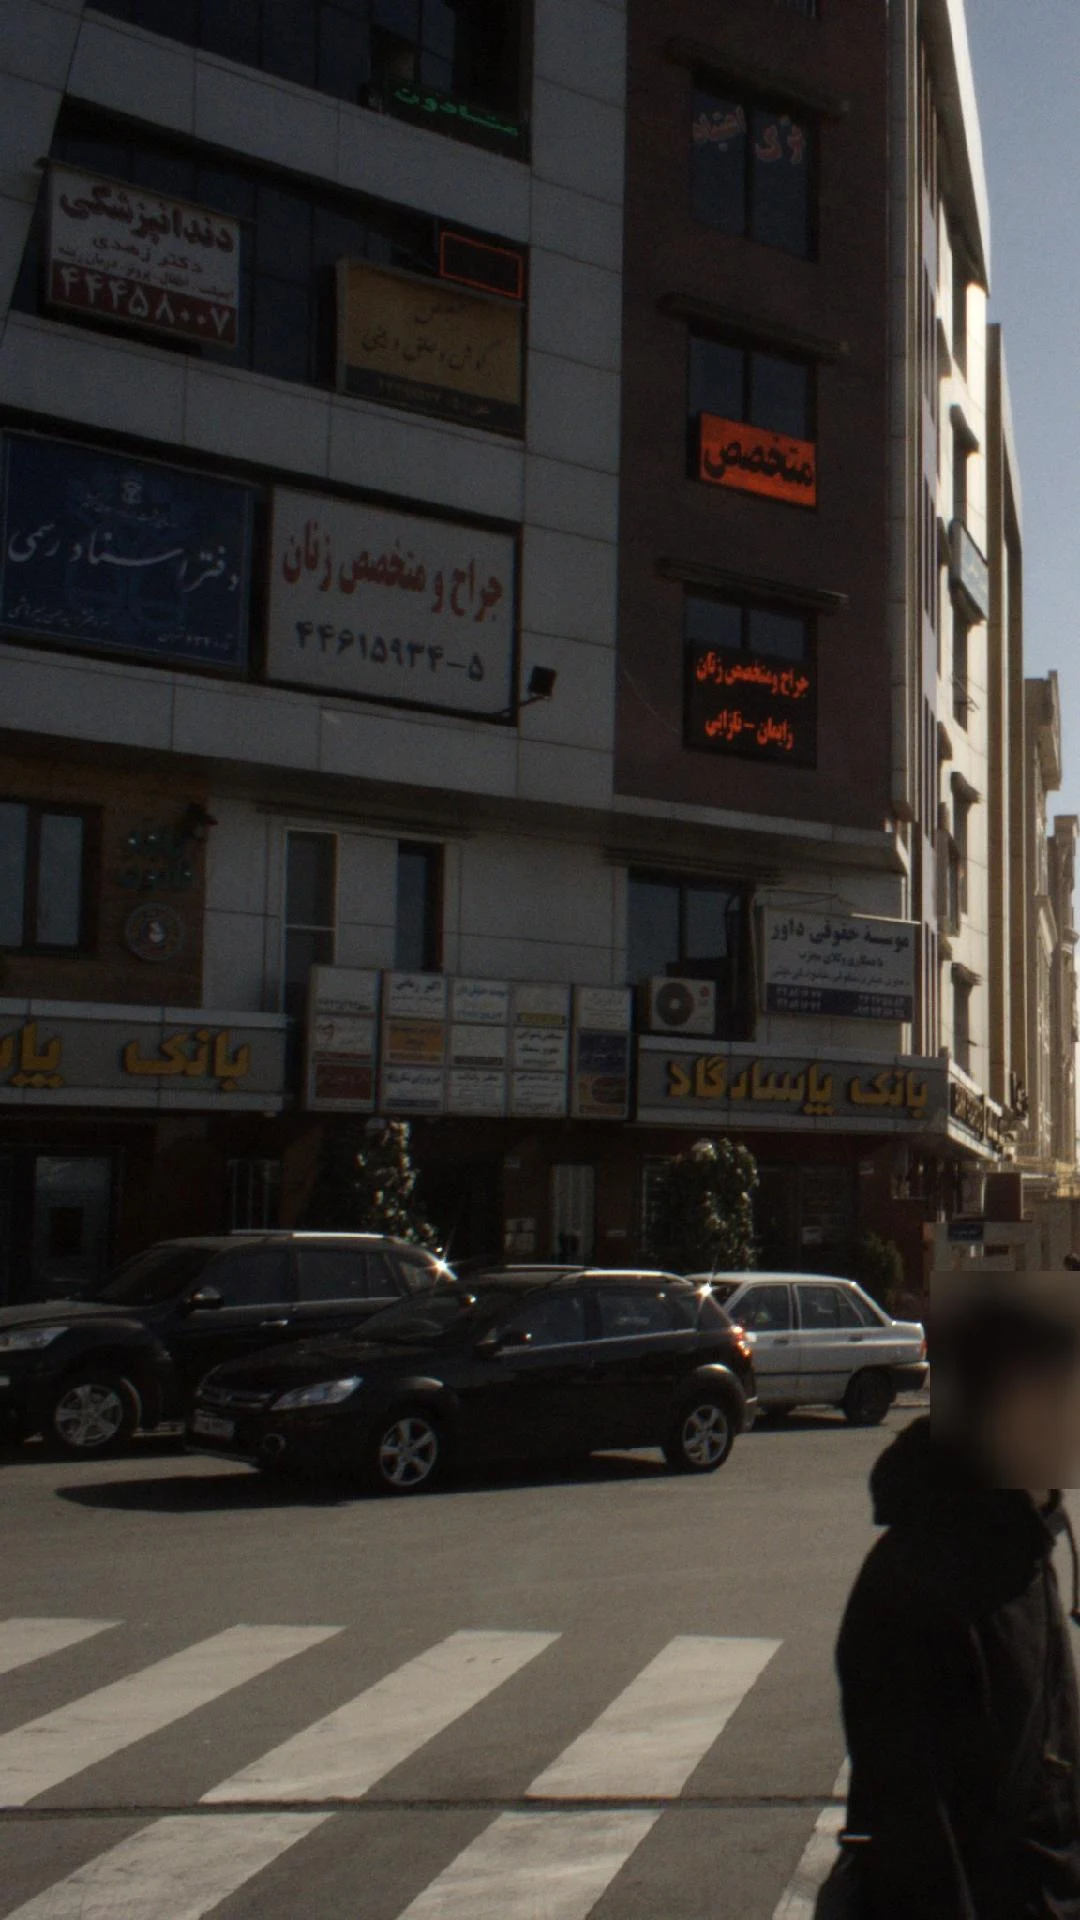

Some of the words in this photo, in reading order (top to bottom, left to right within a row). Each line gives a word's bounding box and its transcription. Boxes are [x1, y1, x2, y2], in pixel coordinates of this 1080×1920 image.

[61, 264, 232, 338] ۴۴۴۵۸۰۰۷
[703, 436, 814, 487] متخصص
[8, 521, 61, 564] رسمی
[69, 526, 189, 585] اسناد
[282, 517, 333, 593] زنان
[338, 538, 427, 595] متخصص
[181, 544, 240, 593] دفتر
[431, 570, 445, 615] و
[449, 558, 503, 623] جراح
[695, 650, 723, 685] زنان
[724, 659, 771, 687] متخصص
[769, 672, 779, 696] و
[780, 667, 810, 699] جراح
[757, 715, 794, 751] زایمان
[769, 916, 806, 943] داور
[808, 919, 860, 948] حقوقی
[122, 1028, 252, 1092] بانک
[666, 1055, 837, 1118] پاسارگاد
[849, 1068, 929, 1119] بانک
